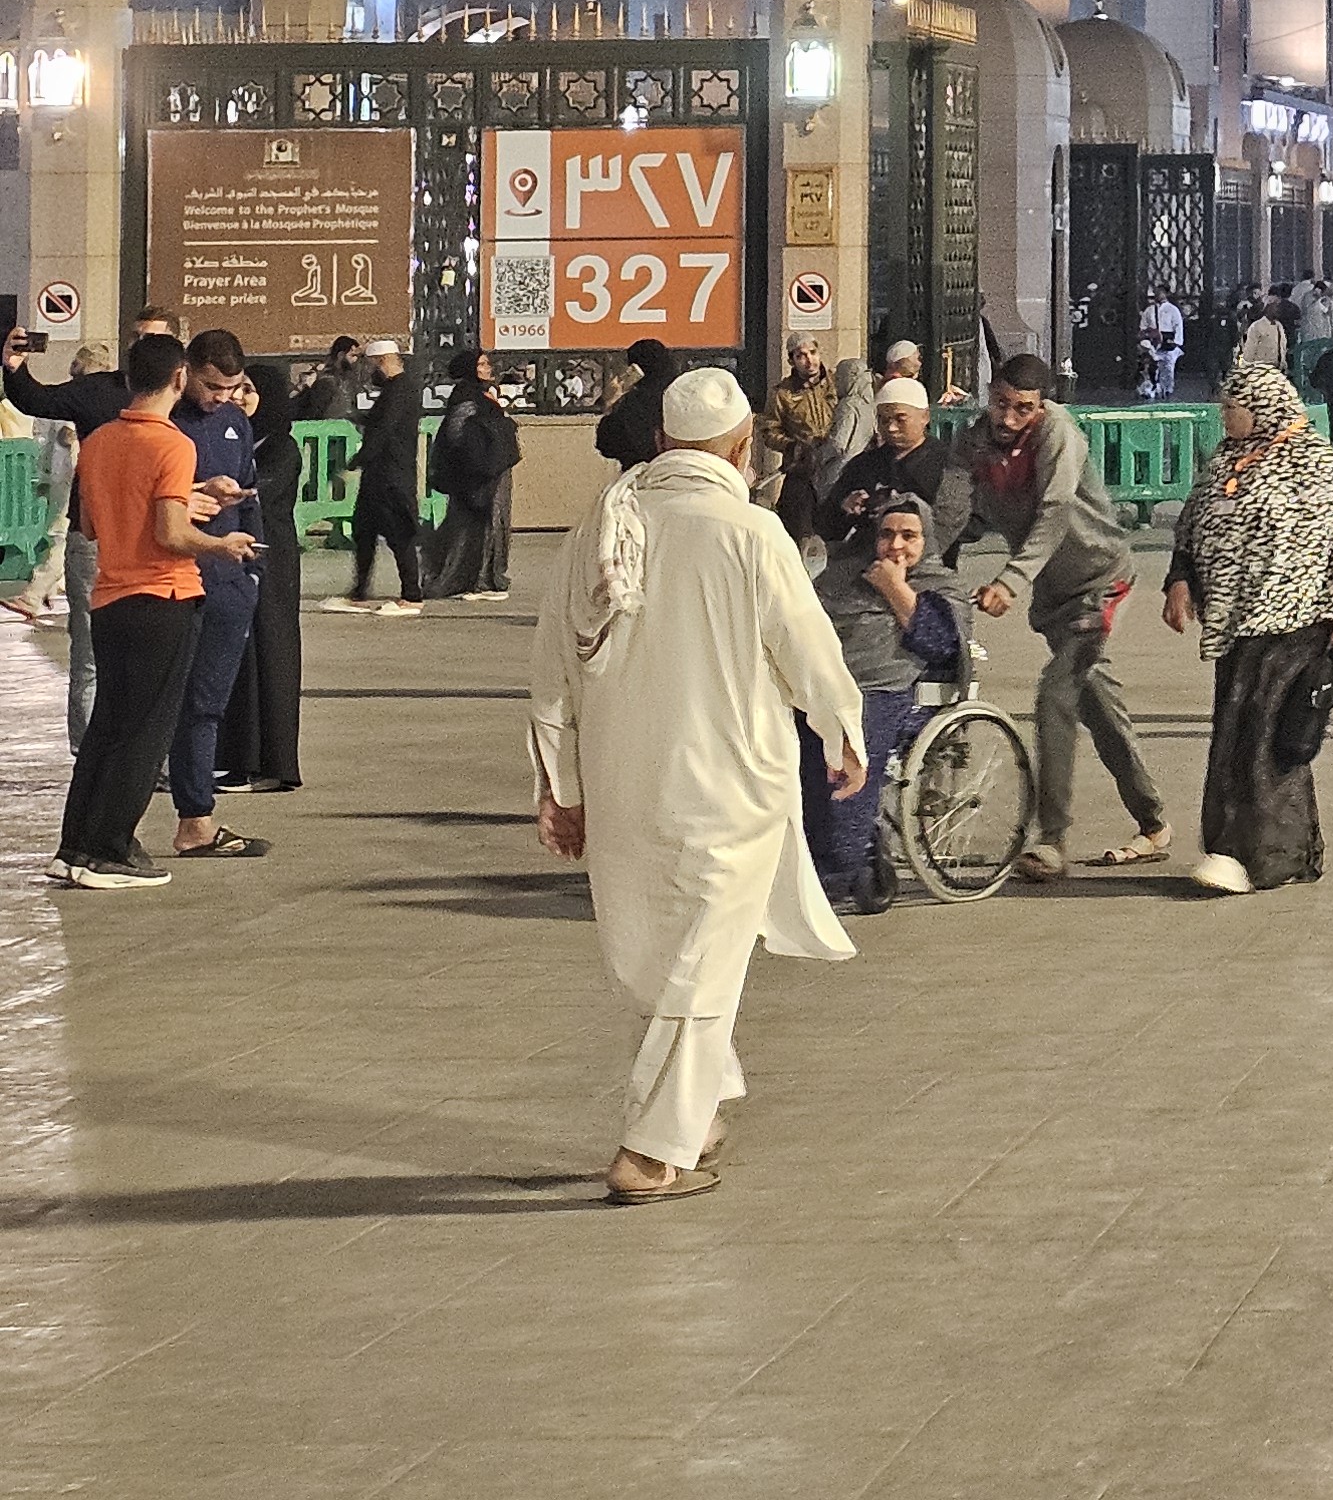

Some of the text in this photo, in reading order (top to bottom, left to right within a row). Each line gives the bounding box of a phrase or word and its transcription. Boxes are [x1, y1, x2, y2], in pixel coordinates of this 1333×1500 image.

[302, 185, 320, 202] في
[564, 152, 735, 230] ٣٢٧
[184, 203, 379, 217] Welcome to the Prophet's Mosque
[182, 219, 240, 231] Bienvenue
[250, 219, 260, 230] la
[261, 219, 311, 232] Mosquée
[183, 254, 269, 269] منطقة صلاة
[183, 274, 267, 289] Prayer Area
[565, 253, 730, 324] 327
[183, 293, 267, 307] Espace prière
[511, 324, 545, 337] 1966
